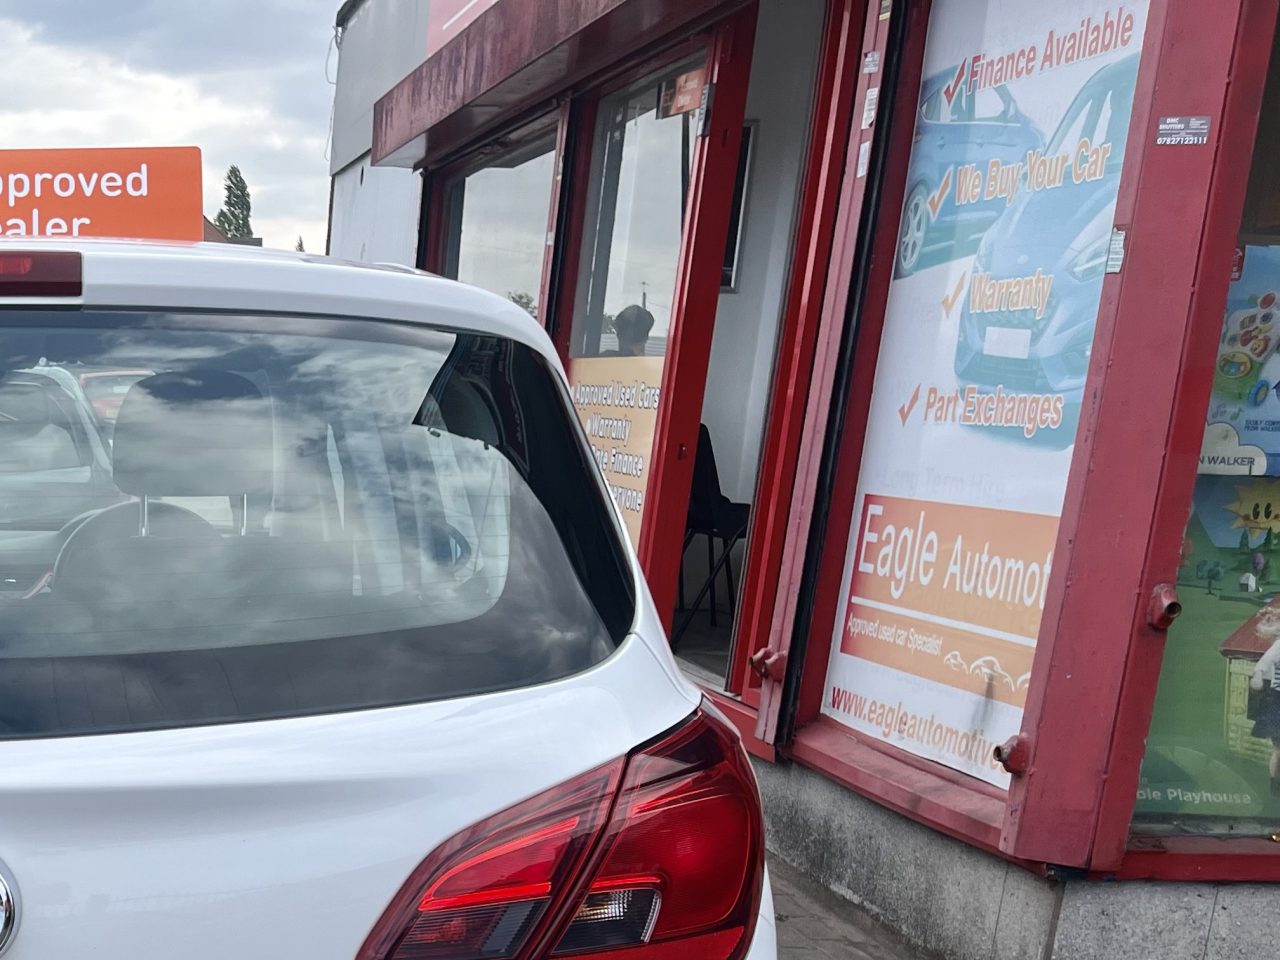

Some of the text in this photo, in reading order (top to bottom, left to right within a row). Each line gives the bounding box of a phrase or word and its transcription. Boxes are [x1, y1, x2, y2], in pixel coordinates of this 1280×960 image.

[966, 7, 1133, 94] Finance Available
[1157, 136, 1207, 144] 07827122111
[956, 138, 1112, 206] We Buy Your Car
[969, 268, 1053, 319] Warranty
[576, 380, 660, 410] Approved Used Cars
[925, 387, 1062, 438] Part Exchanges
[592, 412, 631, 446] Warranty
[611, 447, 643, 477] Finance
[1208, 456, 1255, 466] WALKER
[858, 504, 938, 599] Eagle
[847, 612, 943, 656] Approved used car Specialist
[1167, 788, 1251, 804] Playhouse
